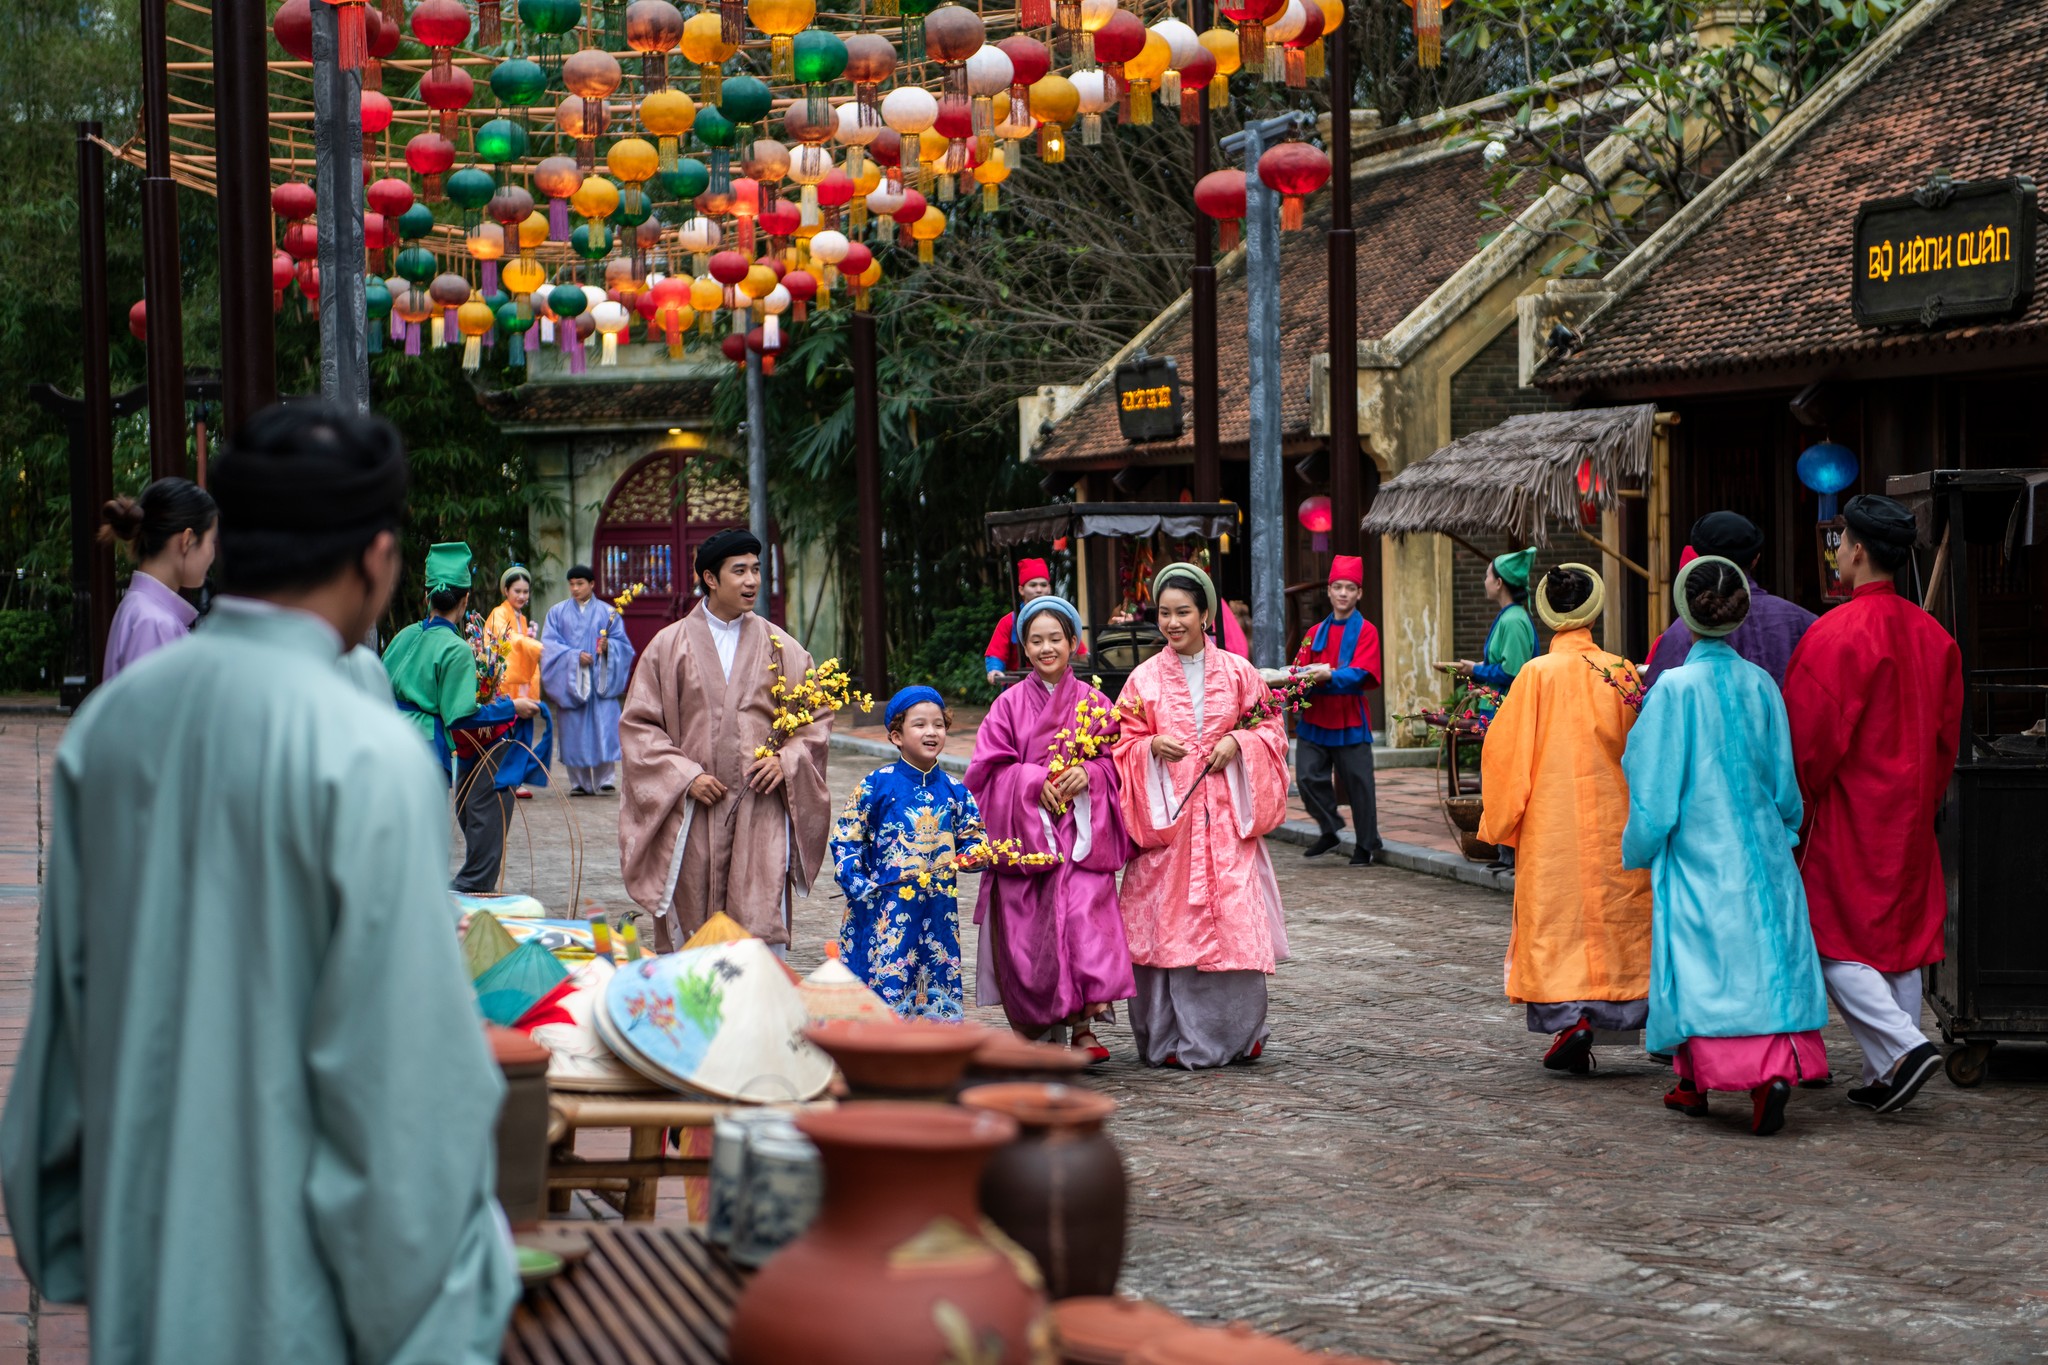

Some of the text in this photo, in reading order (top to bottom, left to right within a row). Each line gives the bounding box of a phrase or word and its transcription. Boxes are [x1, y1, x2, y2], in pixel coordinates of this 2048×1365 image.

[1868, 224, 2010, 282] BỘ HÀNH QUÁN
